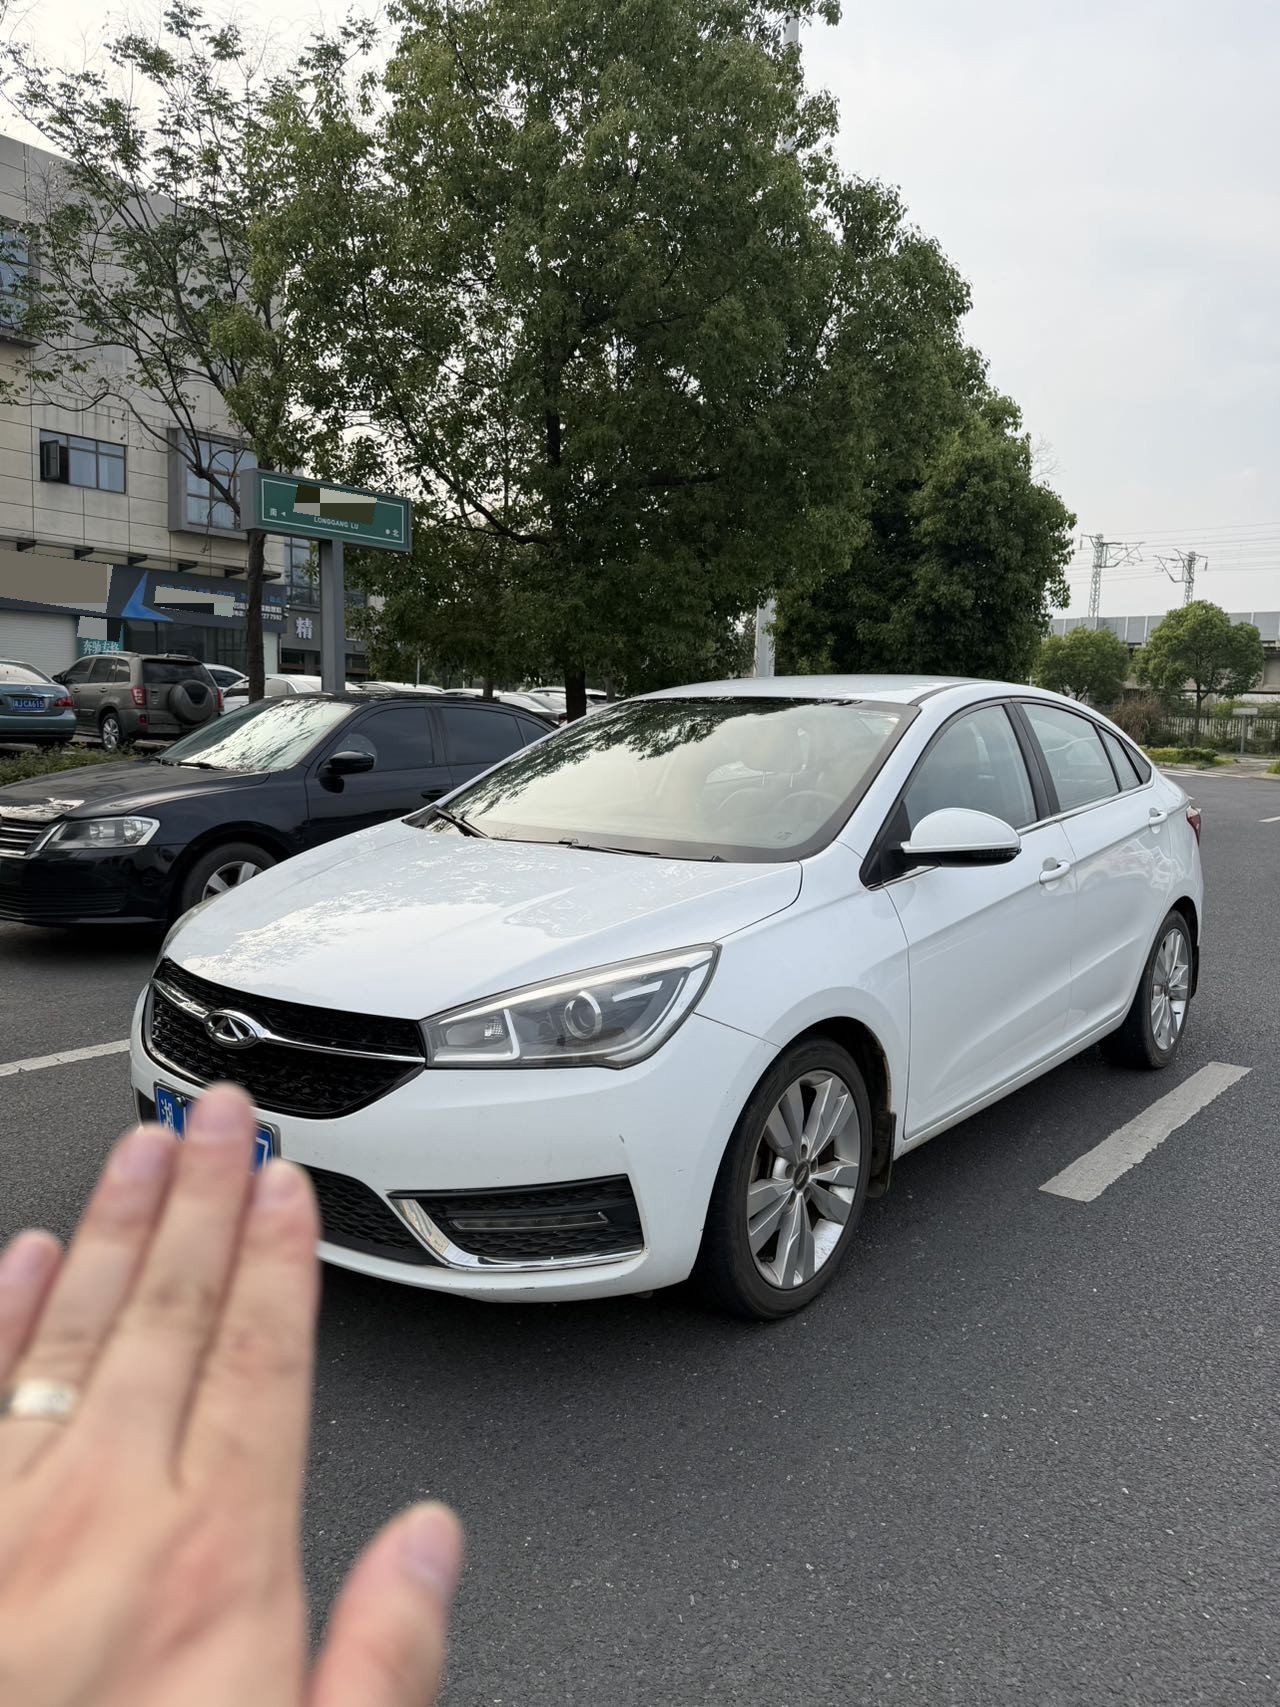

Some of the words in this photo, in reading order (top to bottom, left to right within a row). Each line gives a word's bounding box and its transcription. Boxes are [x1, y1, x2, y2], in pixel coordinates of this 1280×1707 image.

[313, 516, 349, 528] LONGGANG
[350, 522, 359, 530] LU
[295, 616, 313, 639] 精
